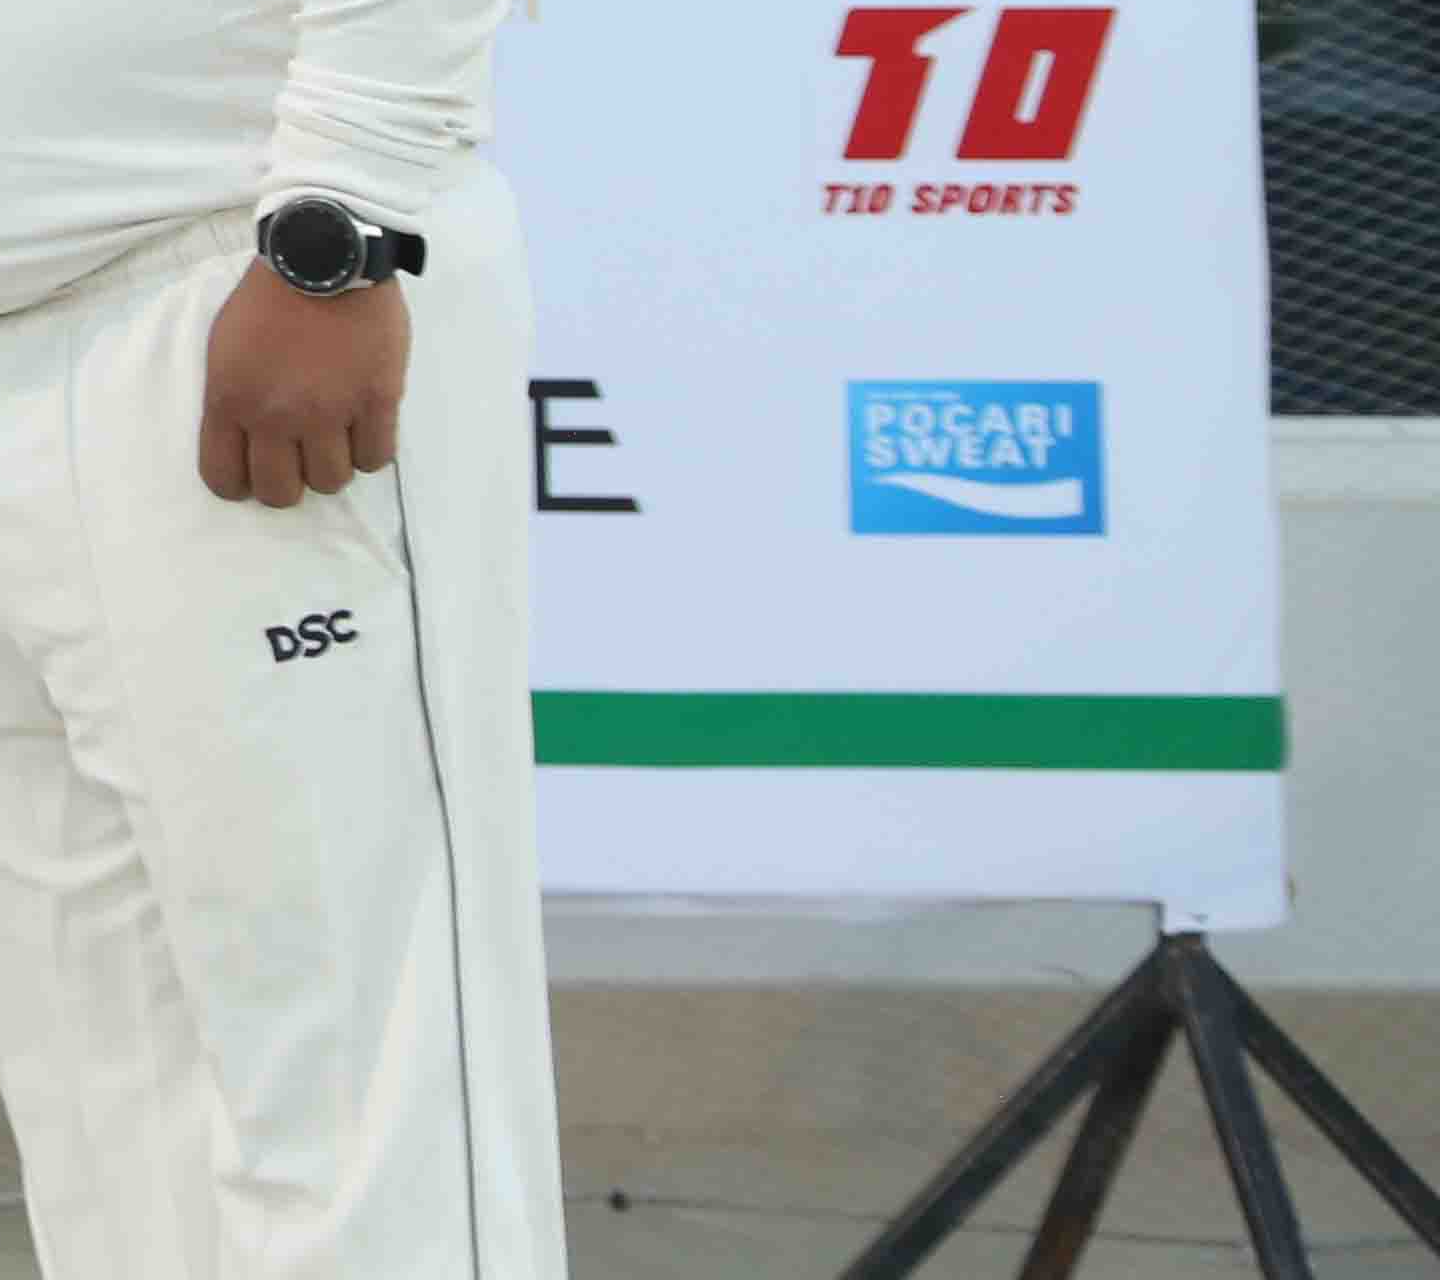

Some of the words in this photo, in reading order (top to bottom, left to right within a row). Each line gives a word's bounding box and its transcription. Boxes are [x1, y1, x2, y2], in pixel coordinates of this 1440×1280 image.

[822, 184, 892, 214] T10
[909, 184, 1078, 214] SPORTS
[866, 402, 1073, 437] POCARI
[864, 435, 1057, 468] SWEAT
[265, 609, 359, 662] DSC
